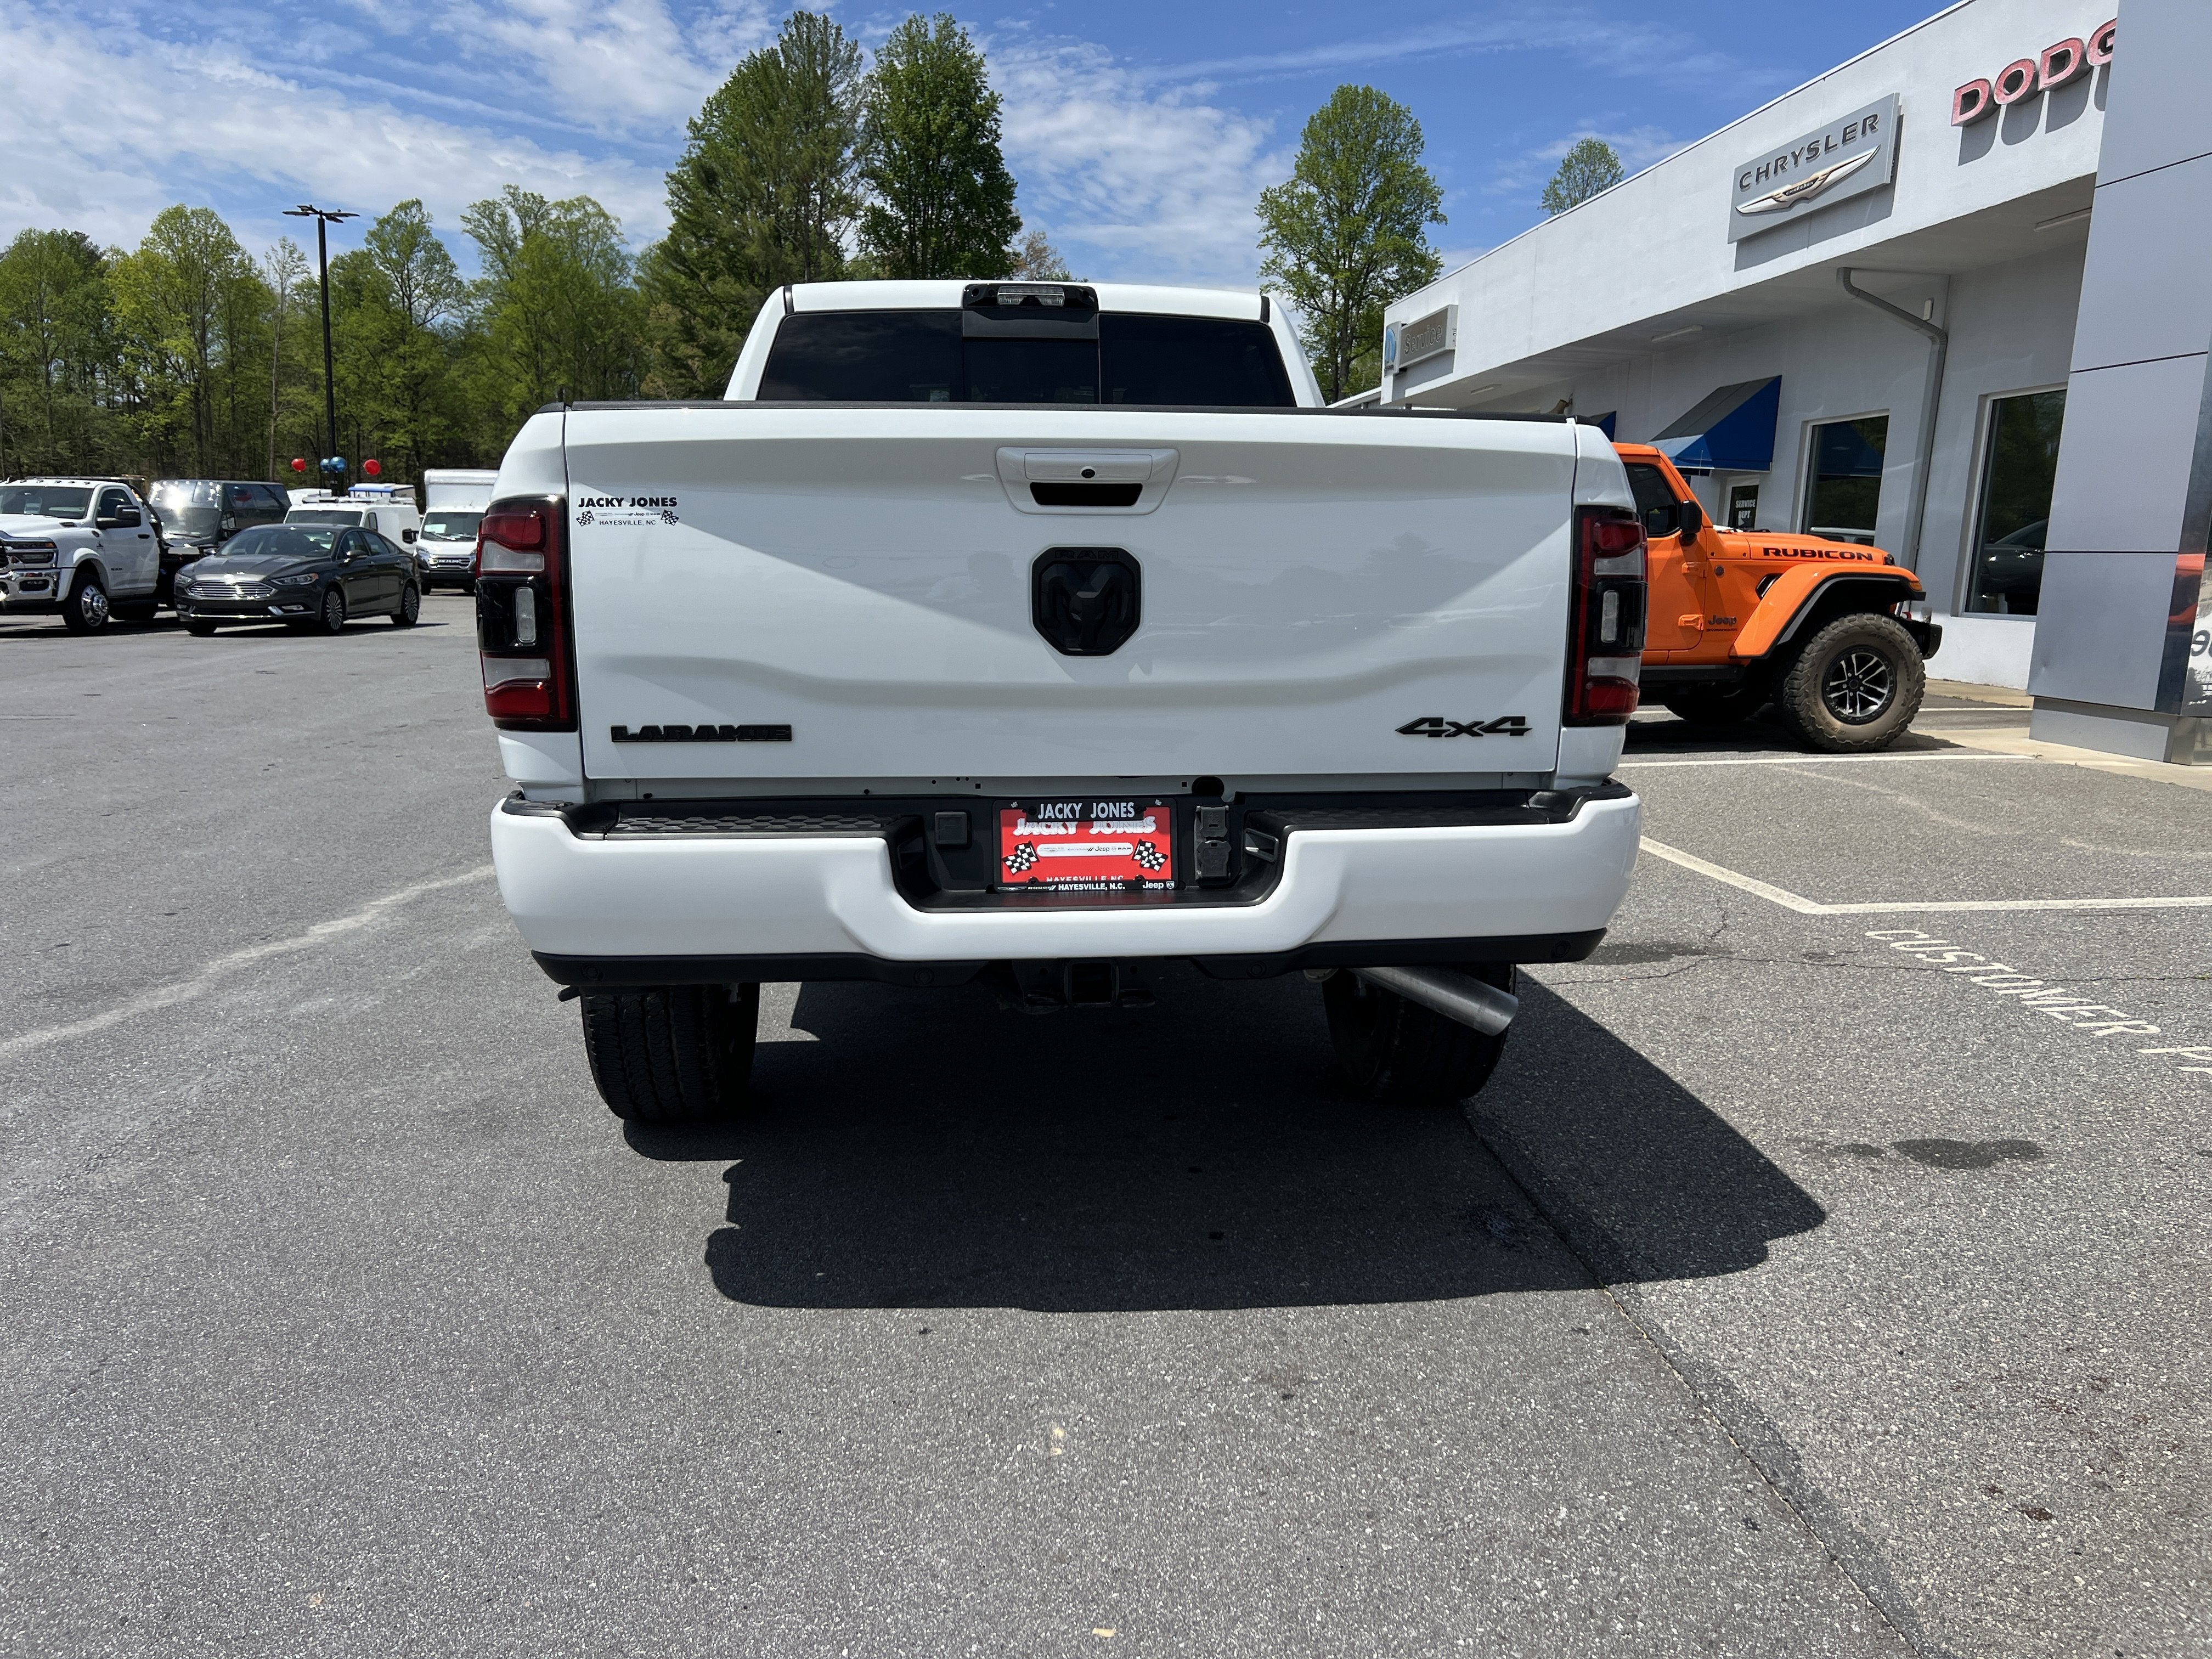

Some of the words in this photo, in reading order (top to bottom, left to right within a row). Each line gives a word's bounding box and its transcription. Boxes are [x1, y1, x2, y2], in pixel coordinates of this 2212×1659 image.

[1739, 114, 1880, 191] CHRYSLER
[578, 497, 624, 508] JACKY
[629, 497, 678, 507] JONES
[1735, 499, 1756, 508] SERVICE
[1738, 510, 1751, 519] DEPT
[1762, 548, 1873, 561] RUBICON
[1708, 614, 1737, 627] Jeep
[610, 724, 793, 743] LARAMIE
[1395, 716, 1533, 737] 4x4
[1038, 803, 1082, 819] JACKY
[1090, 802, 1135, 818] JONES
[1013, 818, 1079, 836] JACKY
[1089, 816, 1157, 834] JONES
[1142, 881, 1164, 890] Jeep
[1865, 930, 2162, 1037] CUSTOMER
